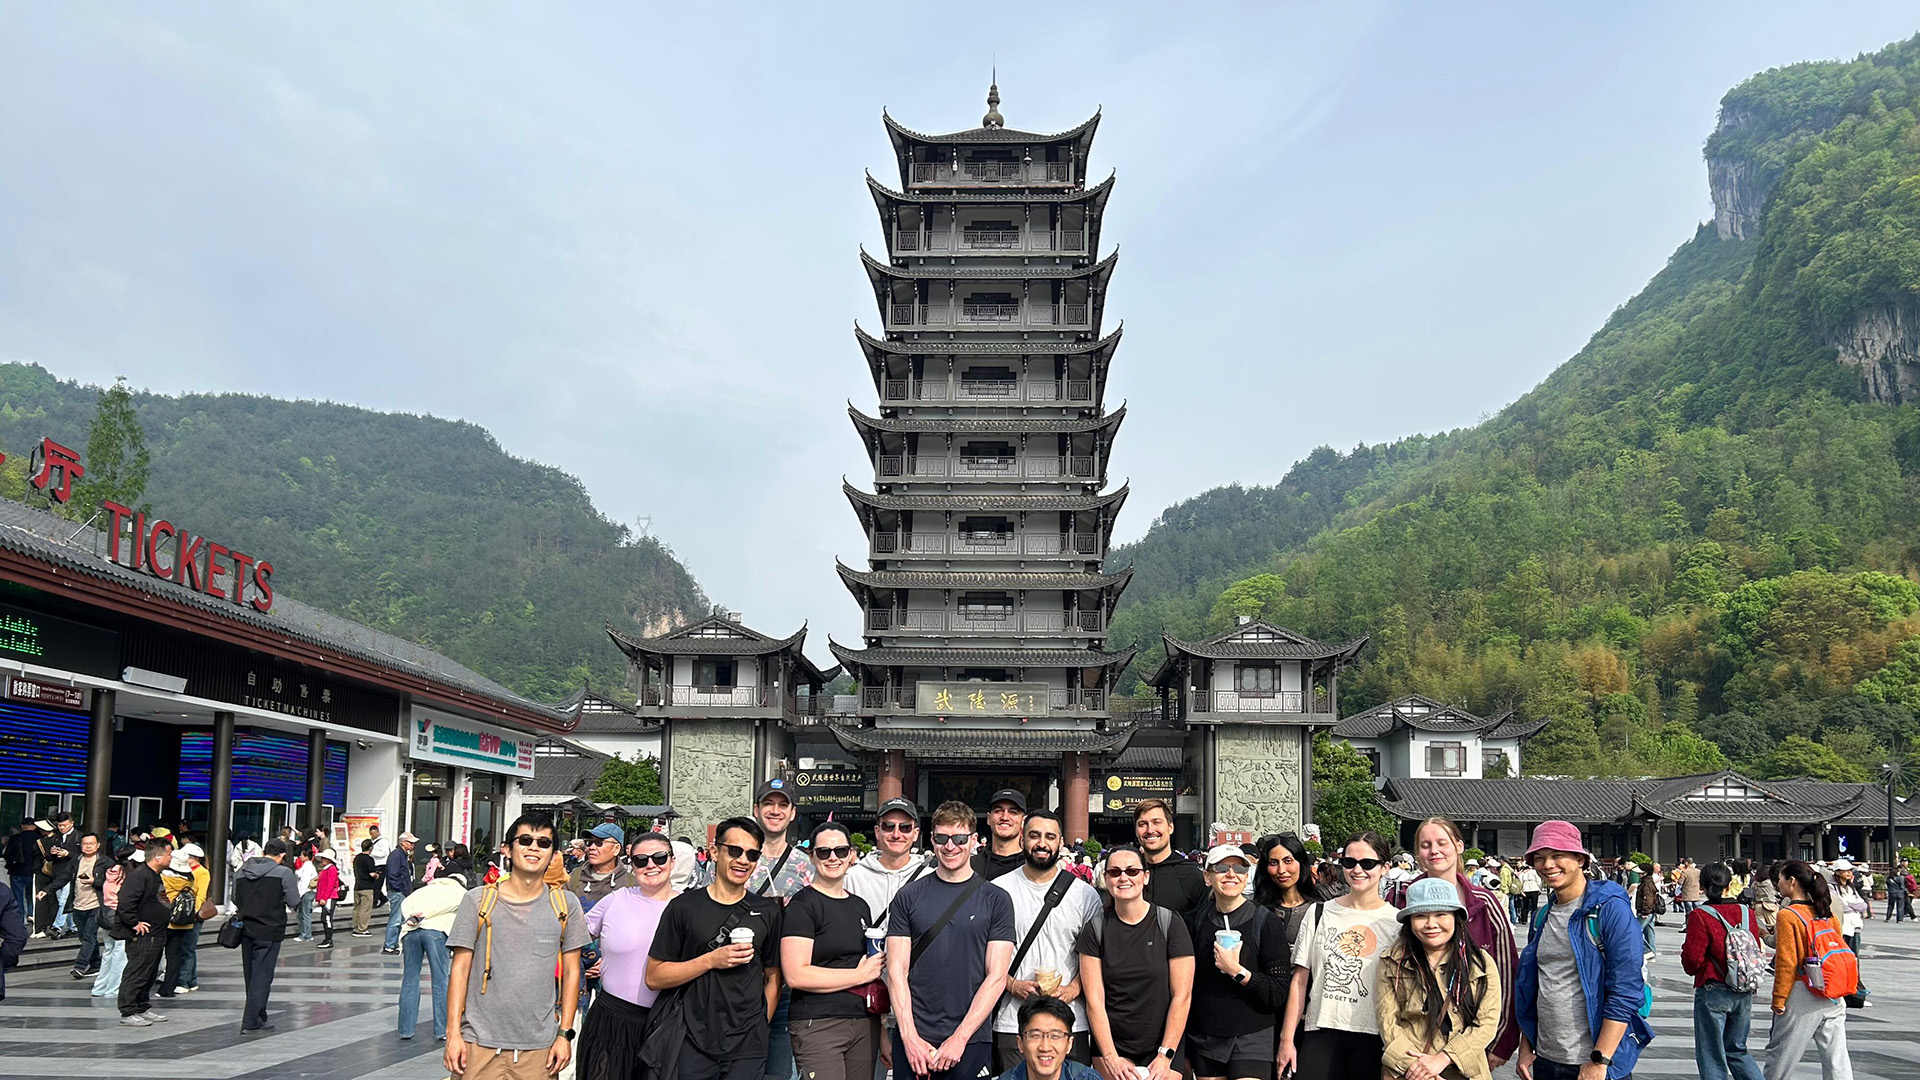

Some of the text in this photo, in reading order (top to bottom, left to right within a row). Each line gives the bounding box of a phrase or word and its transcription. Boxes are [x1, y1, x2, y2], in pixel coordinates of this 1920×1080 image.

[104, 500, 274, 613] TICKETS
[247, 671, 331, 703] 自助售票
[934, 688, 1018, 711] 武陵源
